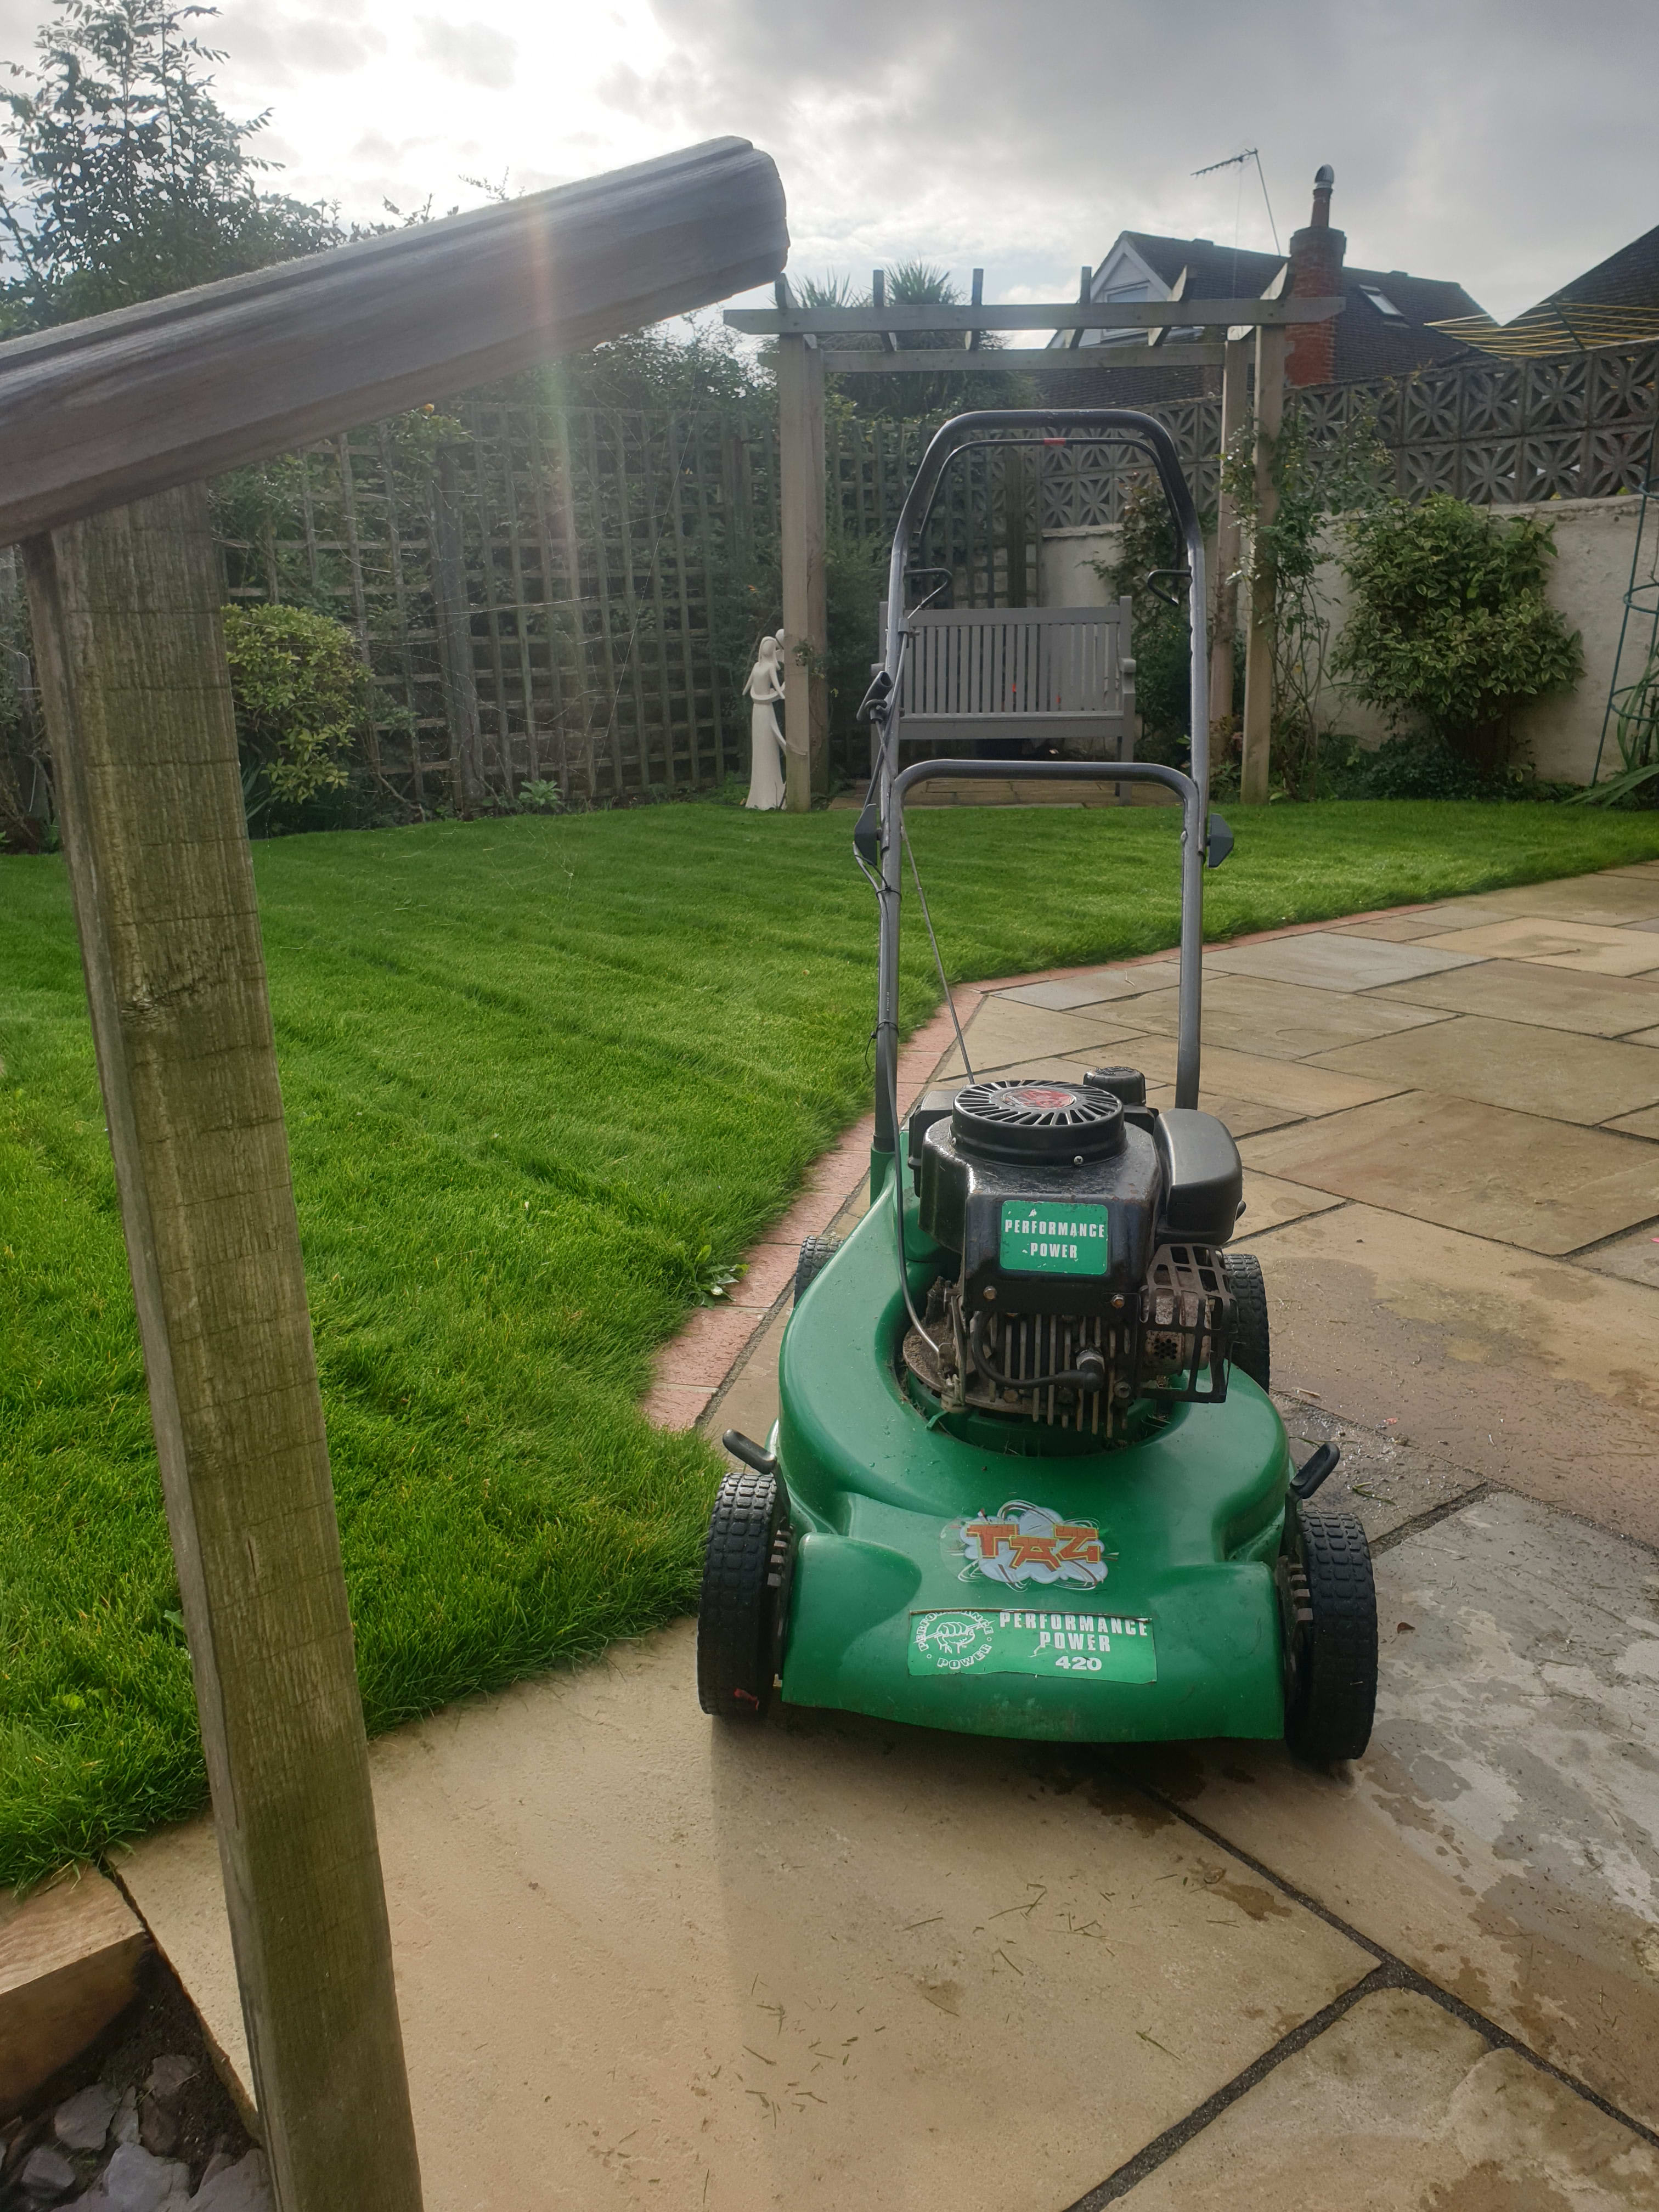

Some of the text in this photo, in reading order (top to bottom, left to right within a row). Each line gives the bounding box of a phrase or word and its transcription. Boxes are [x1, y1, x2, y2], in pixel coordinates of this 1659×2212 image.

[1005, 1219, 1104, 1238] PERFORMANCE
[1030, 1243, 1077, 1259] POWER
[966, 1523, 1102, 1571] TAZ
[1000, 1612, 1148, 1636] PERFORMANCE
[1040, 1631, 1110, 1652] POWER
[937, 1644, 992, 1670] POWER
[1055, 1656, 1102, 1671] 420
